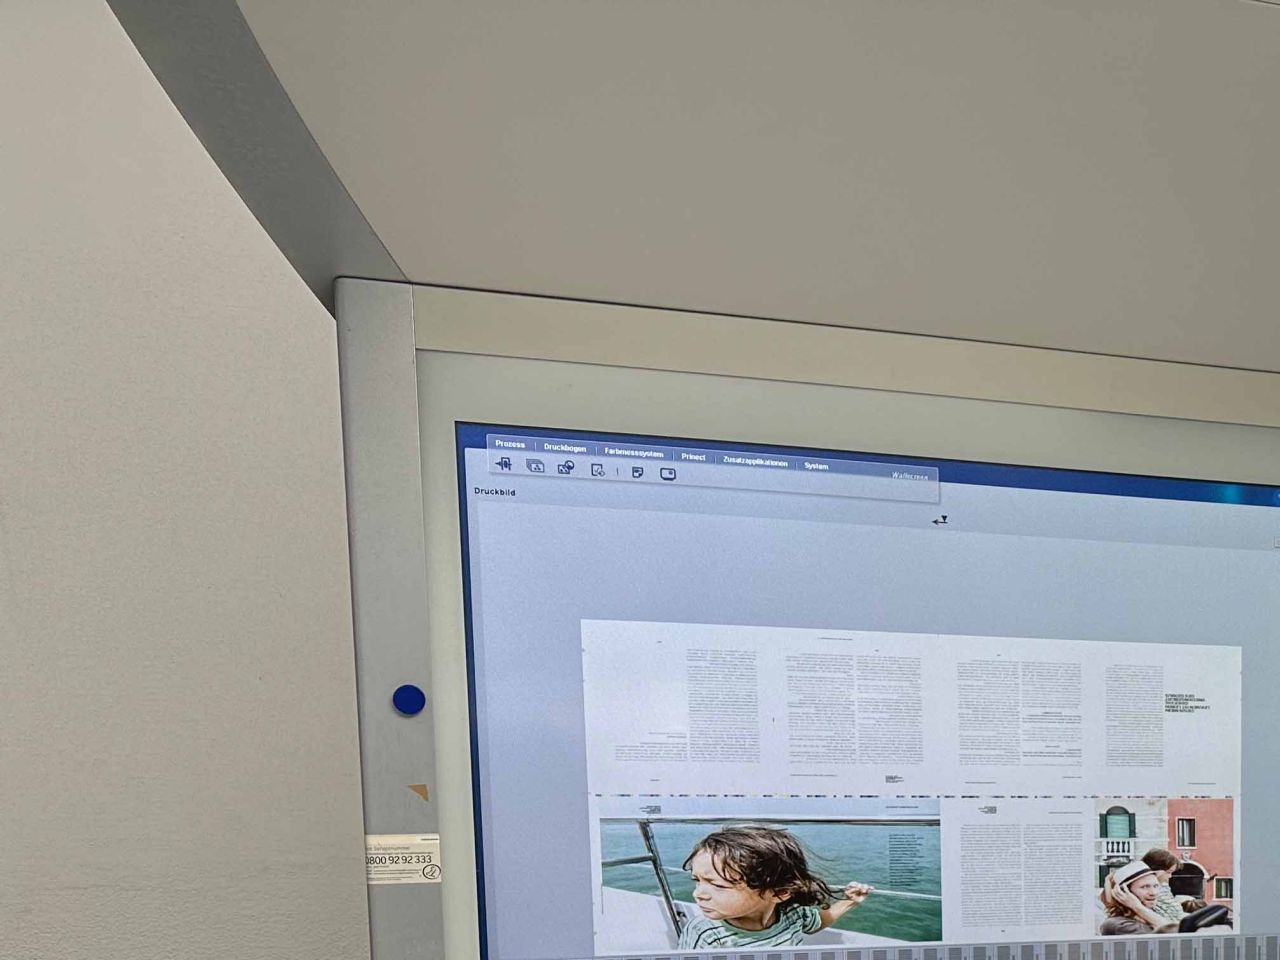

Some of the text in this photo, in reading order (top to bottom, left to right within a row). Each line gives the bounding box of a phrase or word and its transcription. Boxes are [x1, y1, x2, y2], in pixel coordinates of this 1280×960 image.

[495, 439, 526, 449] Prozess
[543, 443, 587, 454] Druckbogen
[681, 452, 706, 462] Prinect
[723, 455, 789, 468] Zusatzapplikationen
[804, 461, 829, 471] System
[474, 487, 516, 497] Druckbild
[365, 854, 432, 865] 0800 92 92 333
